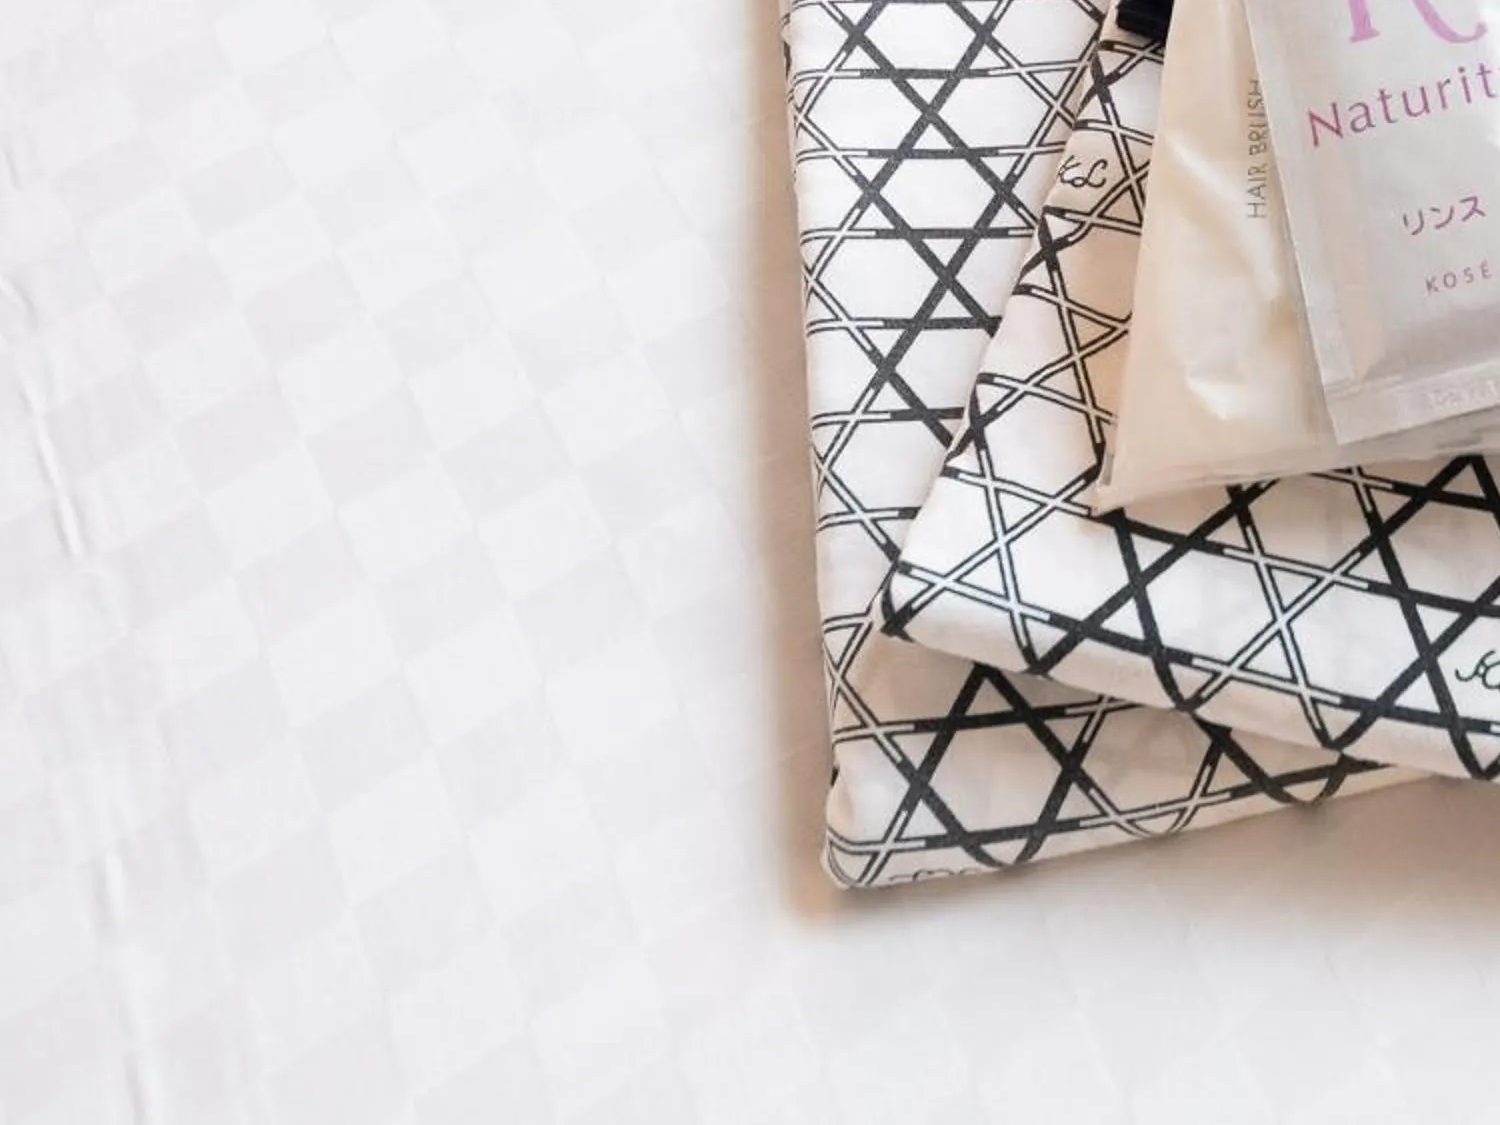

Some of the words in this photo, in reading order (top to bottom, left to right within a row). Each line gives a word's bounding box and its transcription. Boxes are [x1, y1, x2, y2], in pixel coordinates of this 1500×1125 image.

[1246, 79, 1269, 156] BRUSH
[1246, 163, 1268, 219] HAIR
[1402, 195, 1487, 236] リンス
